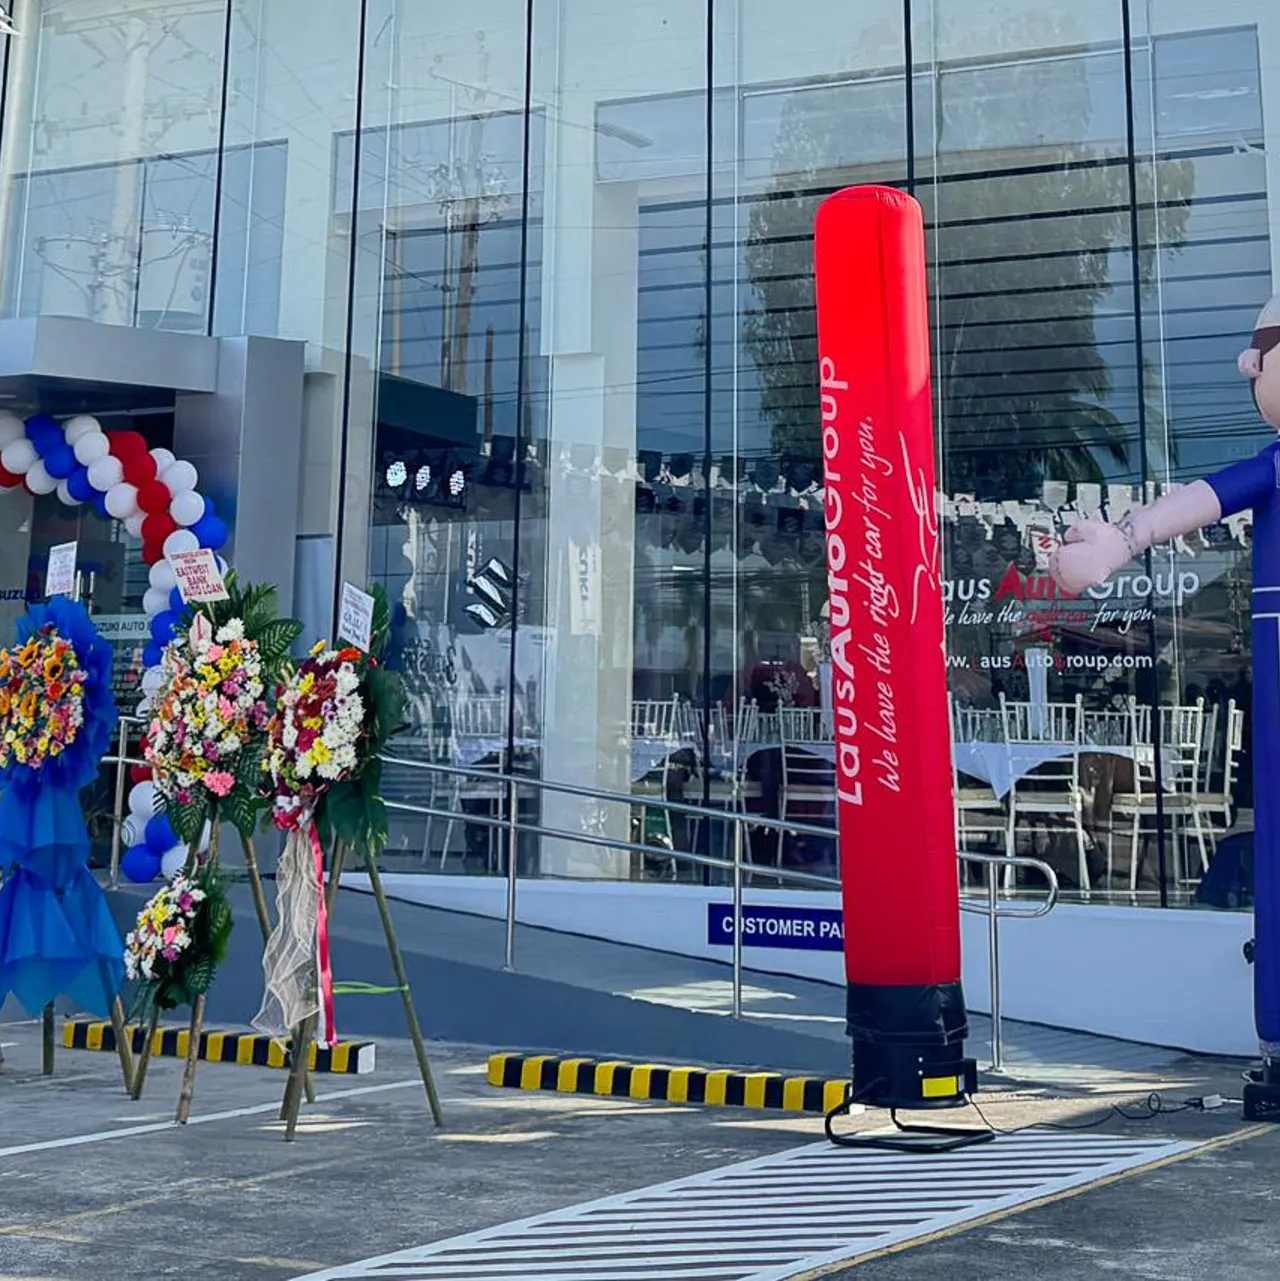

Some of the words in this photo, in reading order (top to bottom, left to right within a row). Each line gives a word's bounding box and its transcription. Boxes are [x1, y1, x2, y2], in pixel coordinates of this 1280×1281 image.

[858, 416, 894, 476] you.
[851, 473, 892, 520] for
[864, 516, 884, 560] car
[819, 355, 863, 807] LausAutoGroup
[852, 559, 900, 627] right
[941, 577, 992, 600] aus
[1087, 571, 1200, 606] Group
[121, 622, 145, 632] AUTO
[957, 601, 992, 626] have
[997, 599, 1022, 626] the
[1089, 602, 1118, 632] for
[1122, 611, 1156, 634] you.
[858, 632, 892, 675] the
[864, 681, 897, 743] have
[872, 751, 901, 793] We
[819, 921, 844, 938] PA
